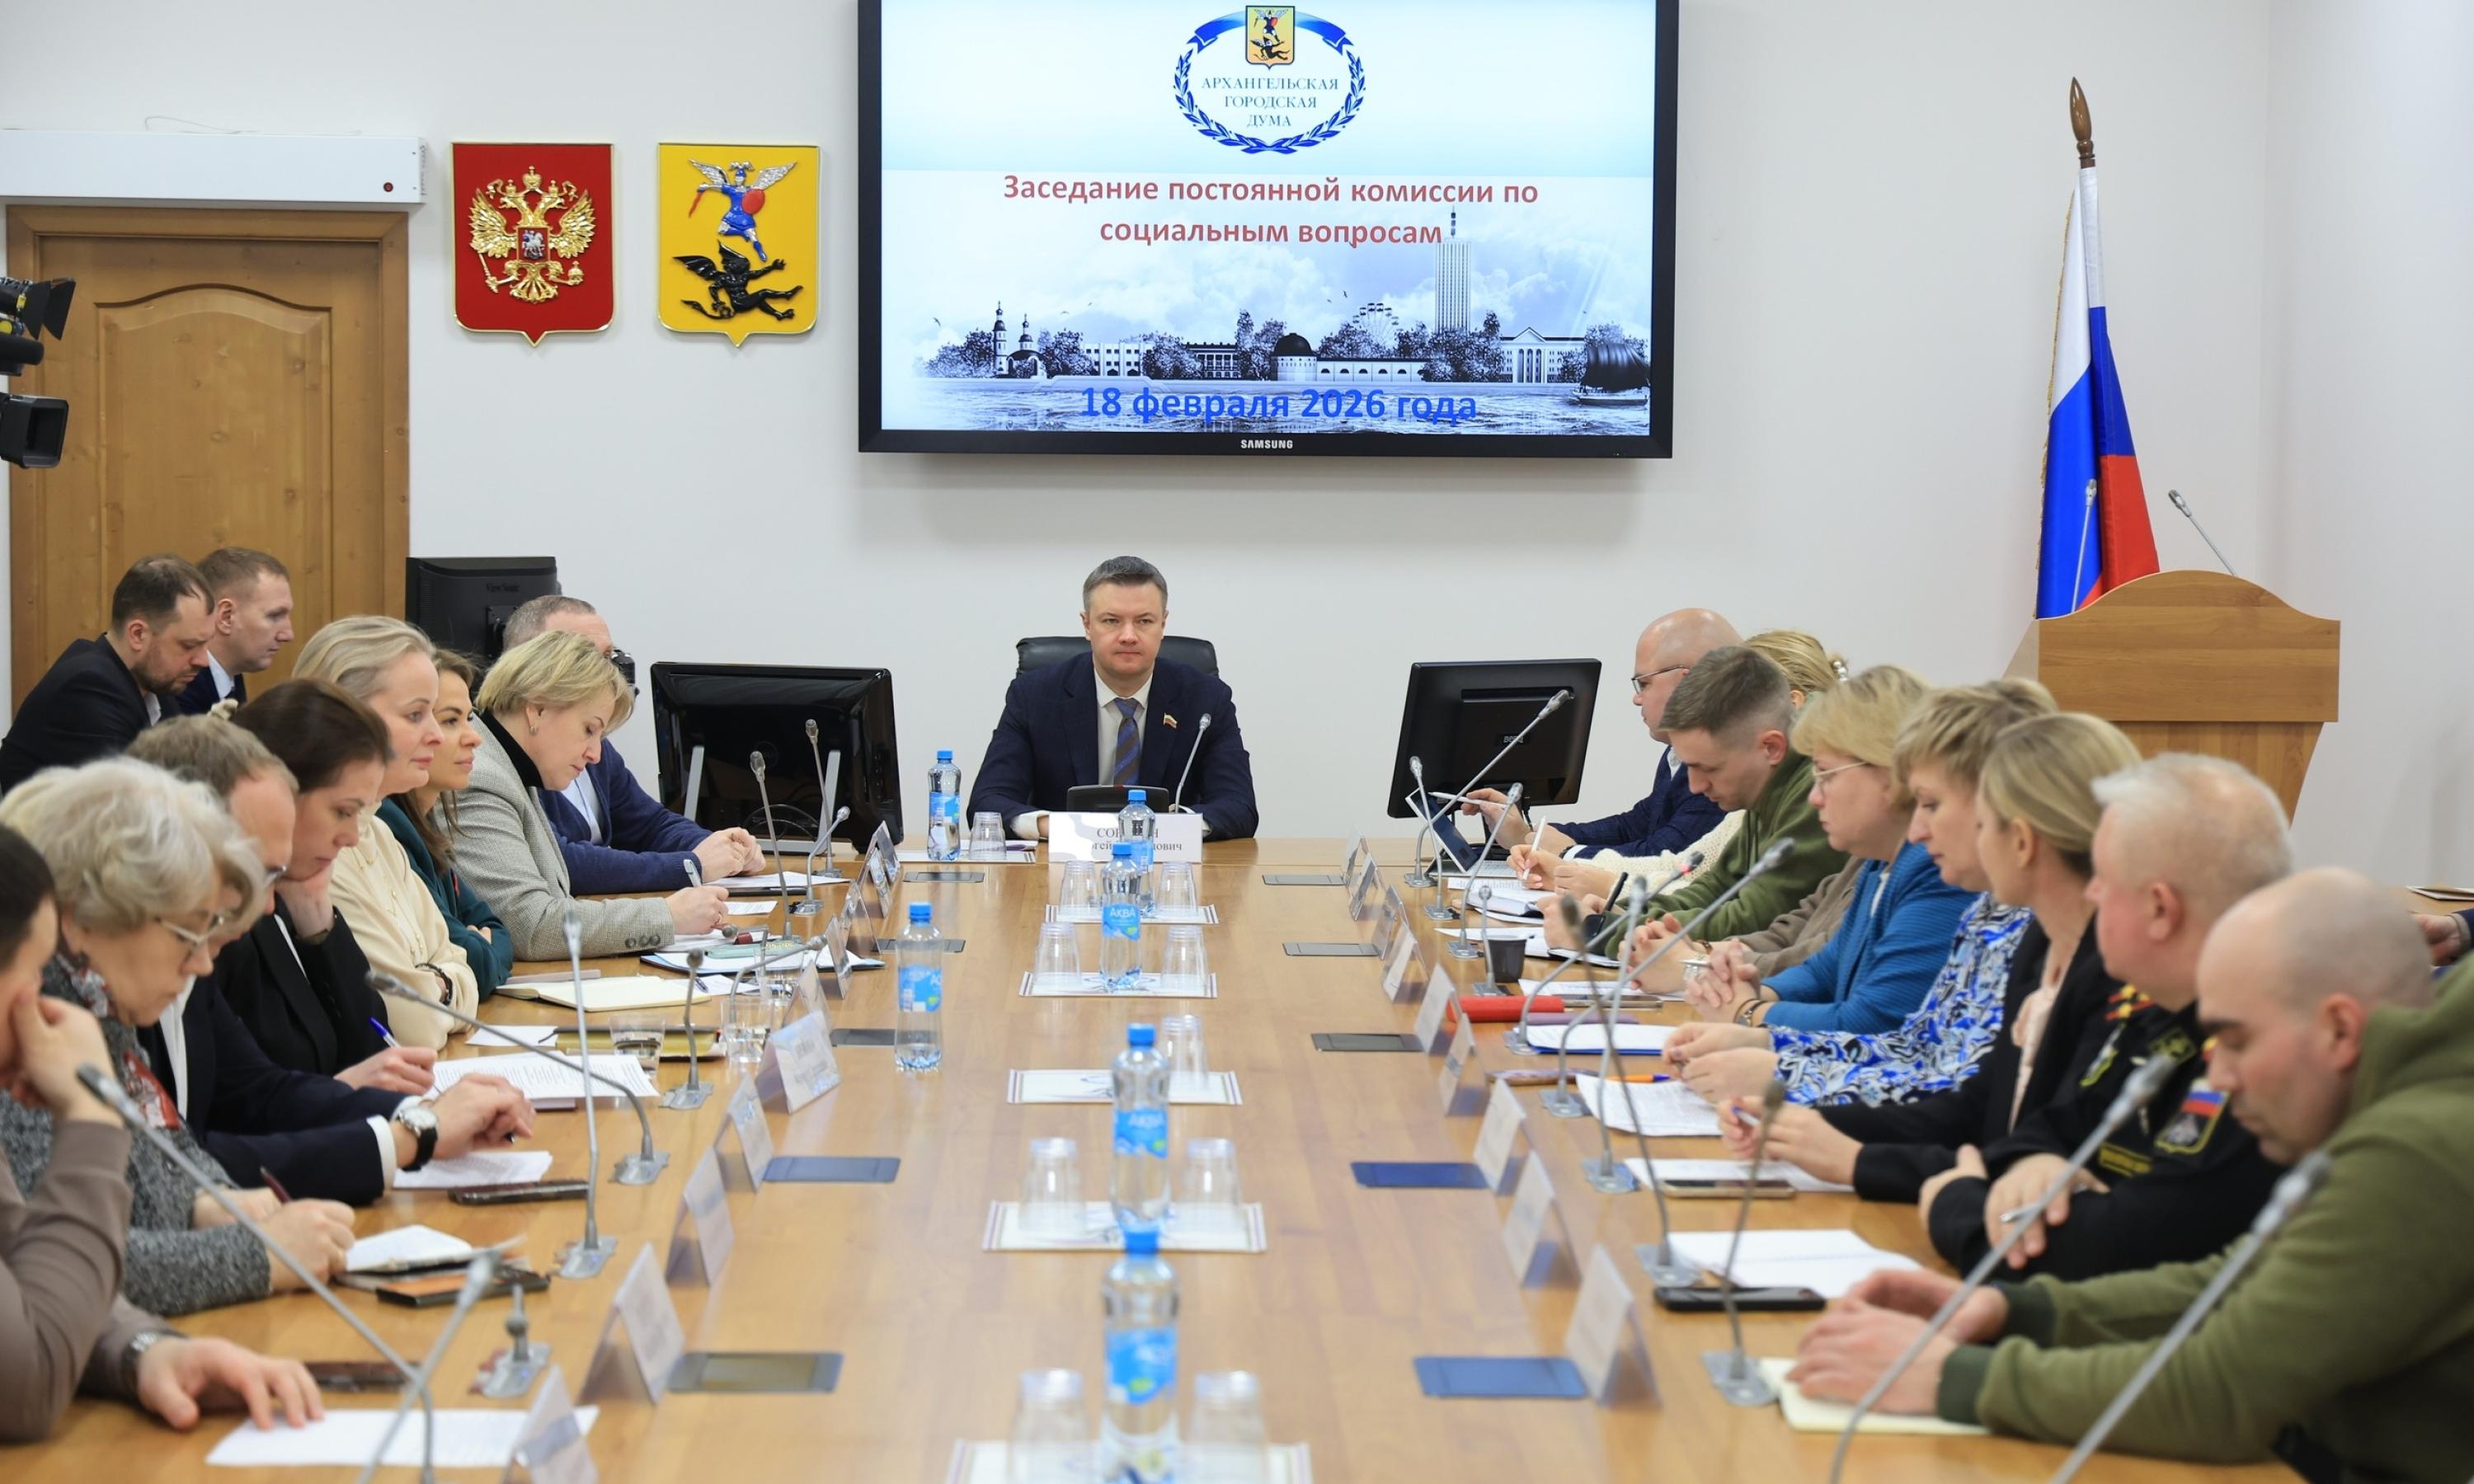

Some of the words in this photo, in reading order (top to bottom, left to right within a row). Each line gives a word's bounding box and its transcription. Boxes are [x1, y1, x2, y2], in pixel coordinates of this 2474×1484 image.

[1202, 77, 1338, 90] АРХАНГЕЛЬСКАЯ
[1225, 96, 1317, 109] ГОРОДСКАЯ
[1246, 115, 1291, 128] ДУМА
[1004, 175, 1158, 204] Заседание
[1169, 176, 1339, 201] постоянной
[1352, 184, 1493, 202] комиссии
[1504, 185, 1538, 203] по
[1100, 223, 1288, 246] социальным
[1298, 224, 1442, 248] вопросам
[1081, 387, 1122, 416] 18
[1132, 387, 1289, 424] февраля
[1302, 389, 1385, 418] 2026
[1398, 396, 1476, 427] года
[1240, 439, 1293, 450] SAMSUNG
